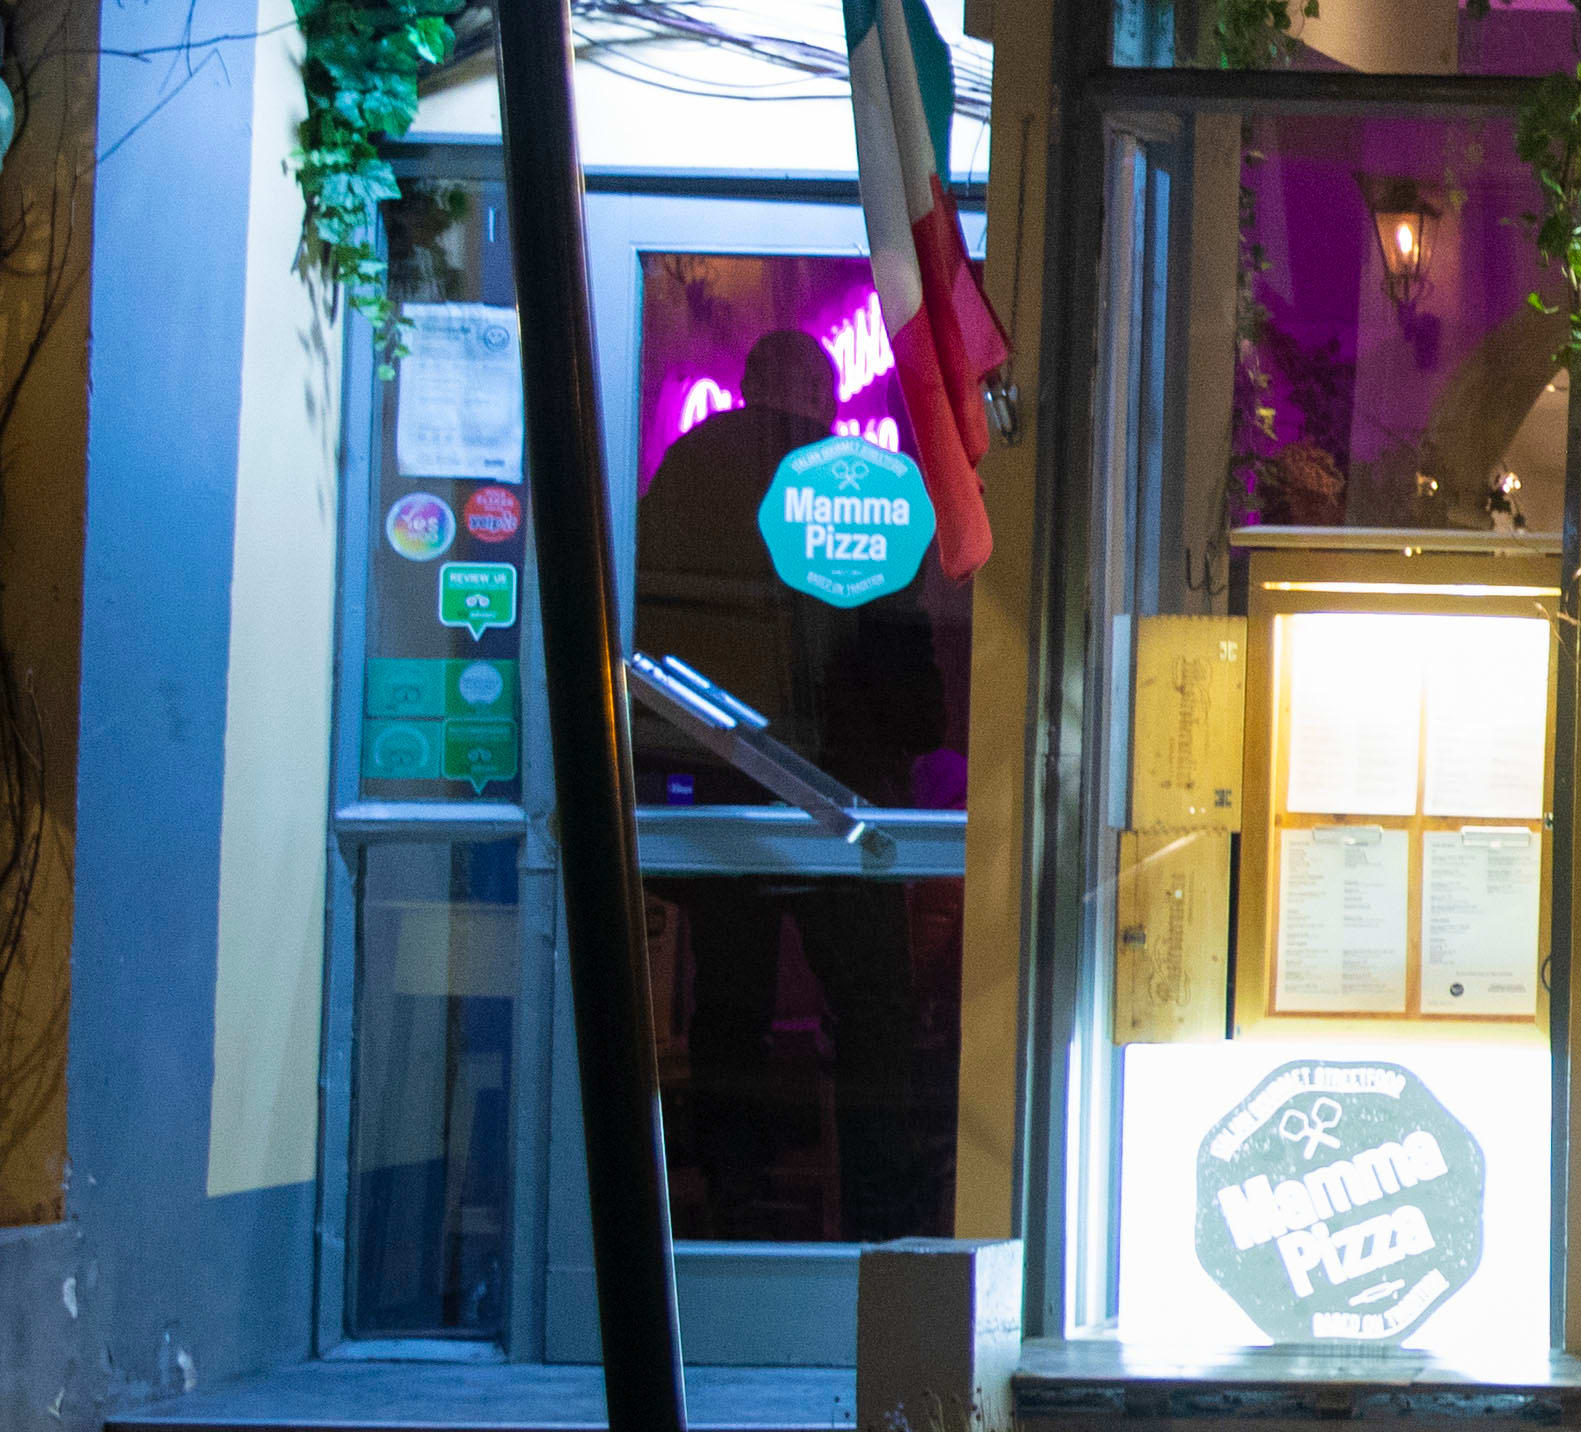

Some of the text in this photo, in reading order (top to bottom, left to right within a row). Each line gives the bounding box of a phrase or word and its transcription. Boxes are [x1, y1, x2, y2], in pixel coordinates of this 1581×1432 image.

[784, 486, 911, 525] Mamma
[805, 524, 887, 561] Pizza
[1217, 1130, 1449, 1251] Mamma
[1276, 1204, 1436, 1299] Pizza
